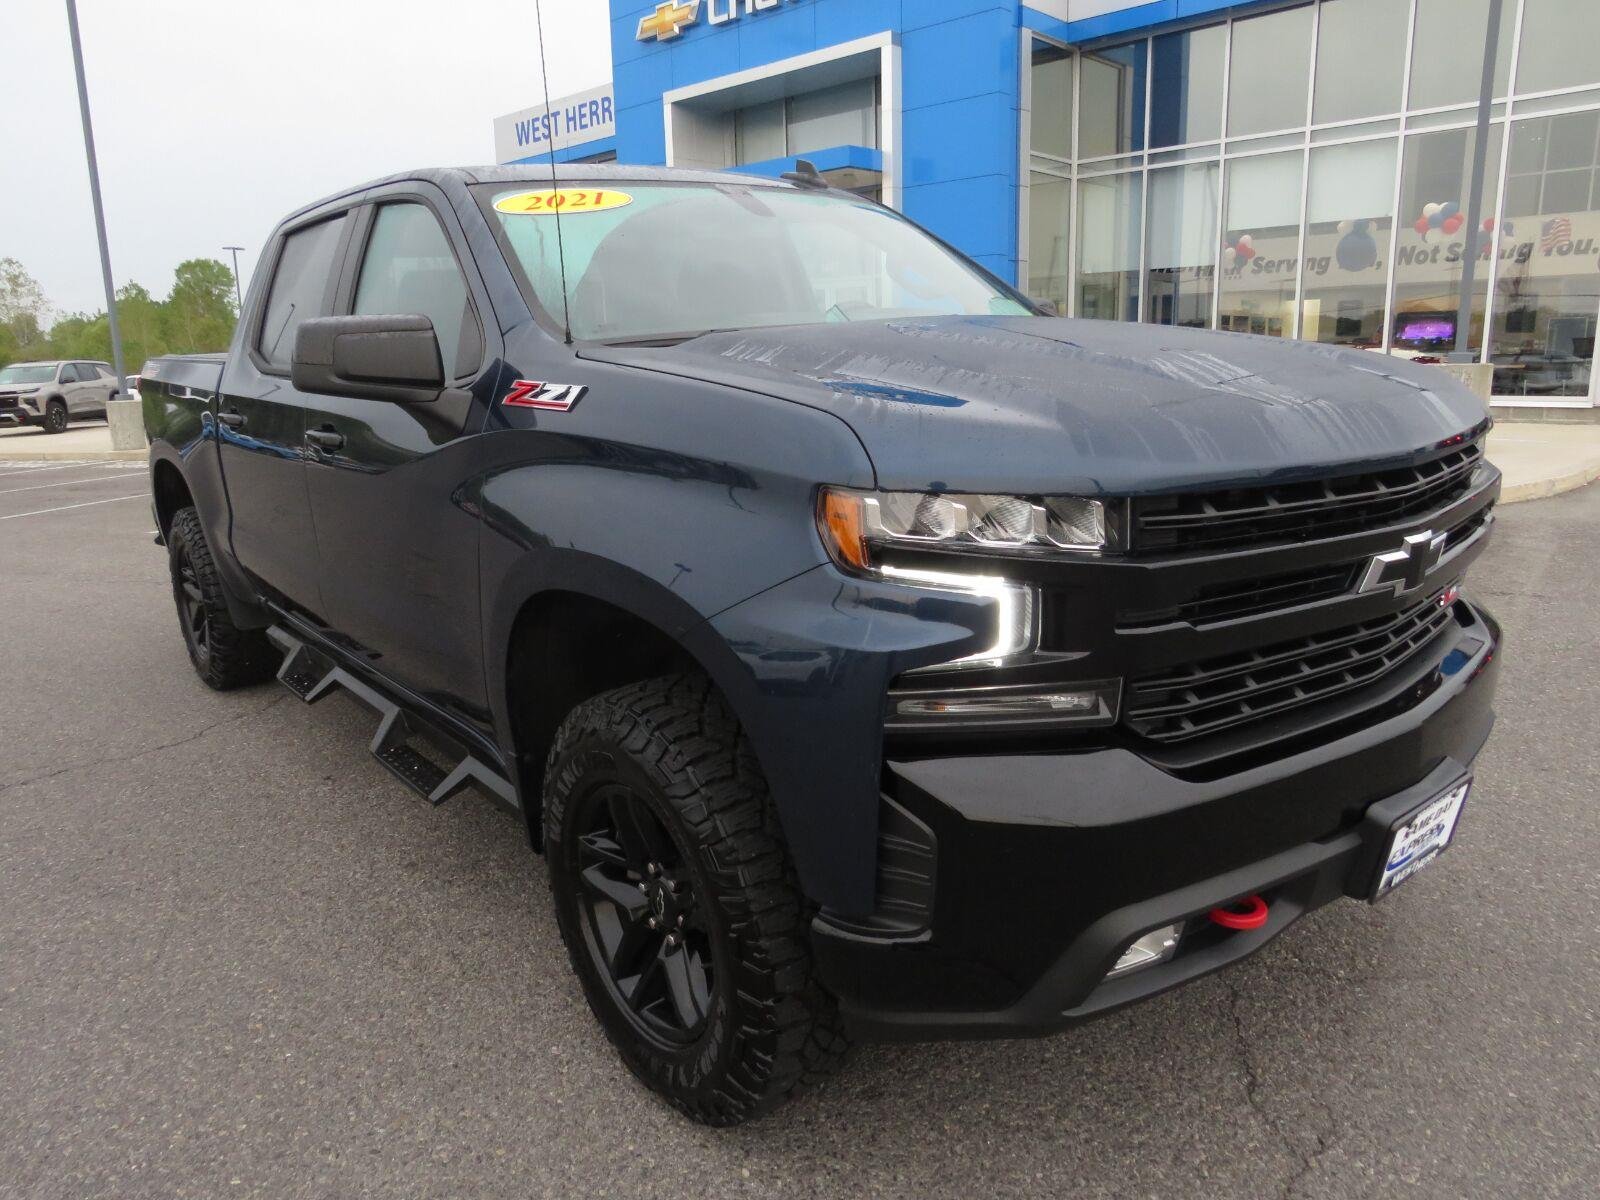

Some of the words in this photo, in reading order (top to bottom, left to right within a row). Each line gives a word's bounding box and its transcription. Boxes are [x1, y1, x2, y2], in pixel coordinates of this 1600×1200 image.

[515, 110, 561, 147] WEST
[565, 96, 613, 133] HERR
[524, 191, 603, 211] 2021
[1250, 256, 1332, 276] Servng
[1397, 244, 1440, 266] Not
[502, 379, 588, 412] Z71
